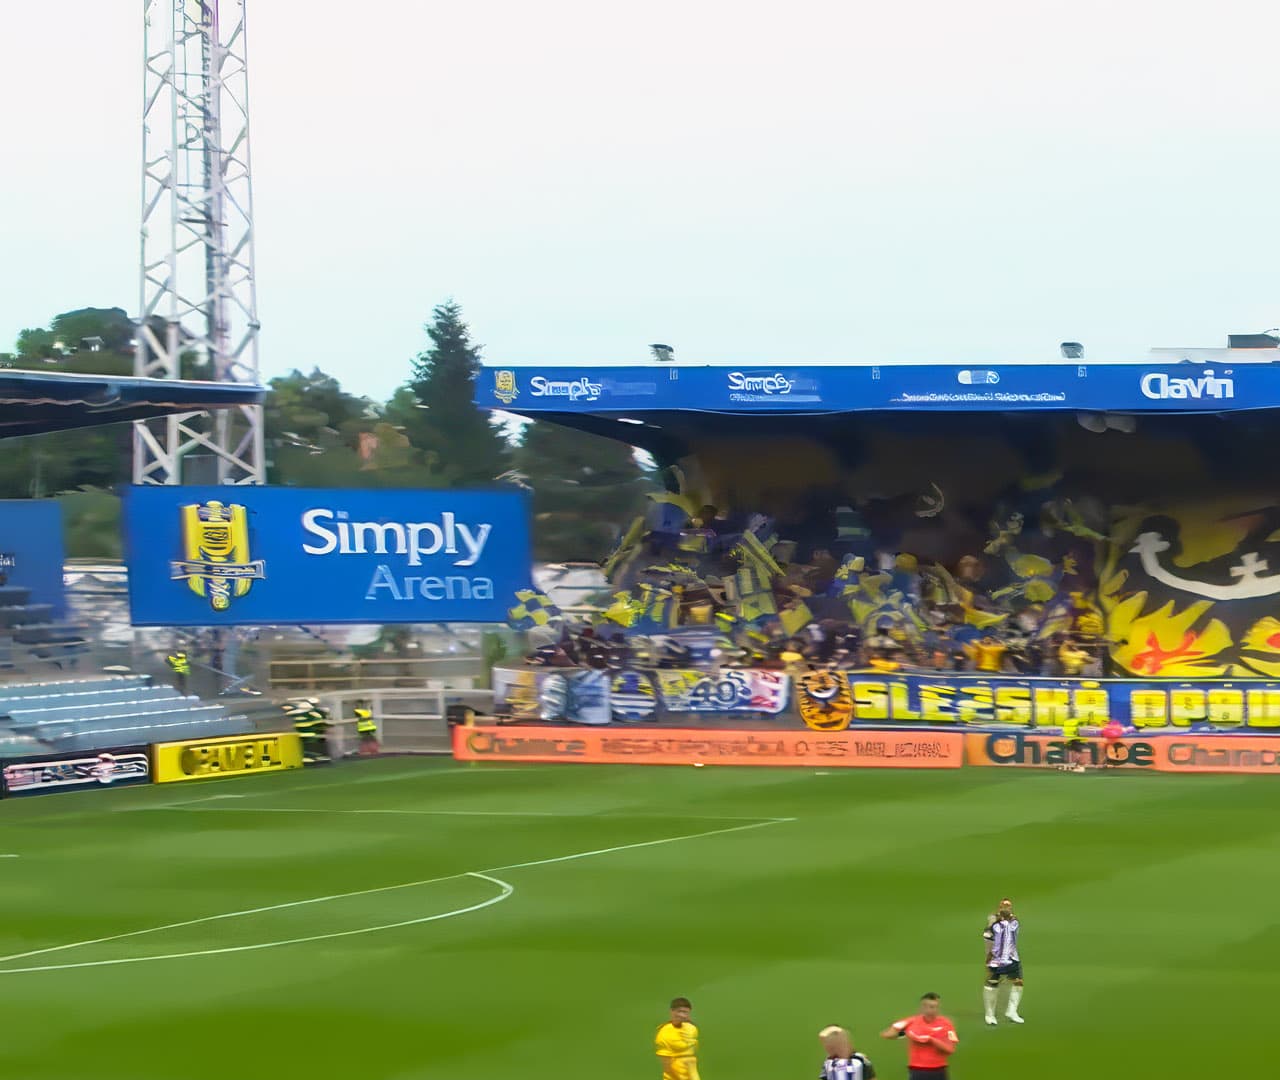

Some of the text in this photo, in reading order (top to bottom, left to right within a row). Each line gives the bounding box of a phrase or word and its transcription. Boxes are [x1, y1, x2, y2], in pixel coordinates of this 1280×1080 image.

[1140, 369, 1235, 399] Clavin
[301, 508, 493, 567] Simply
[364, 564, 495, 601] Arena
